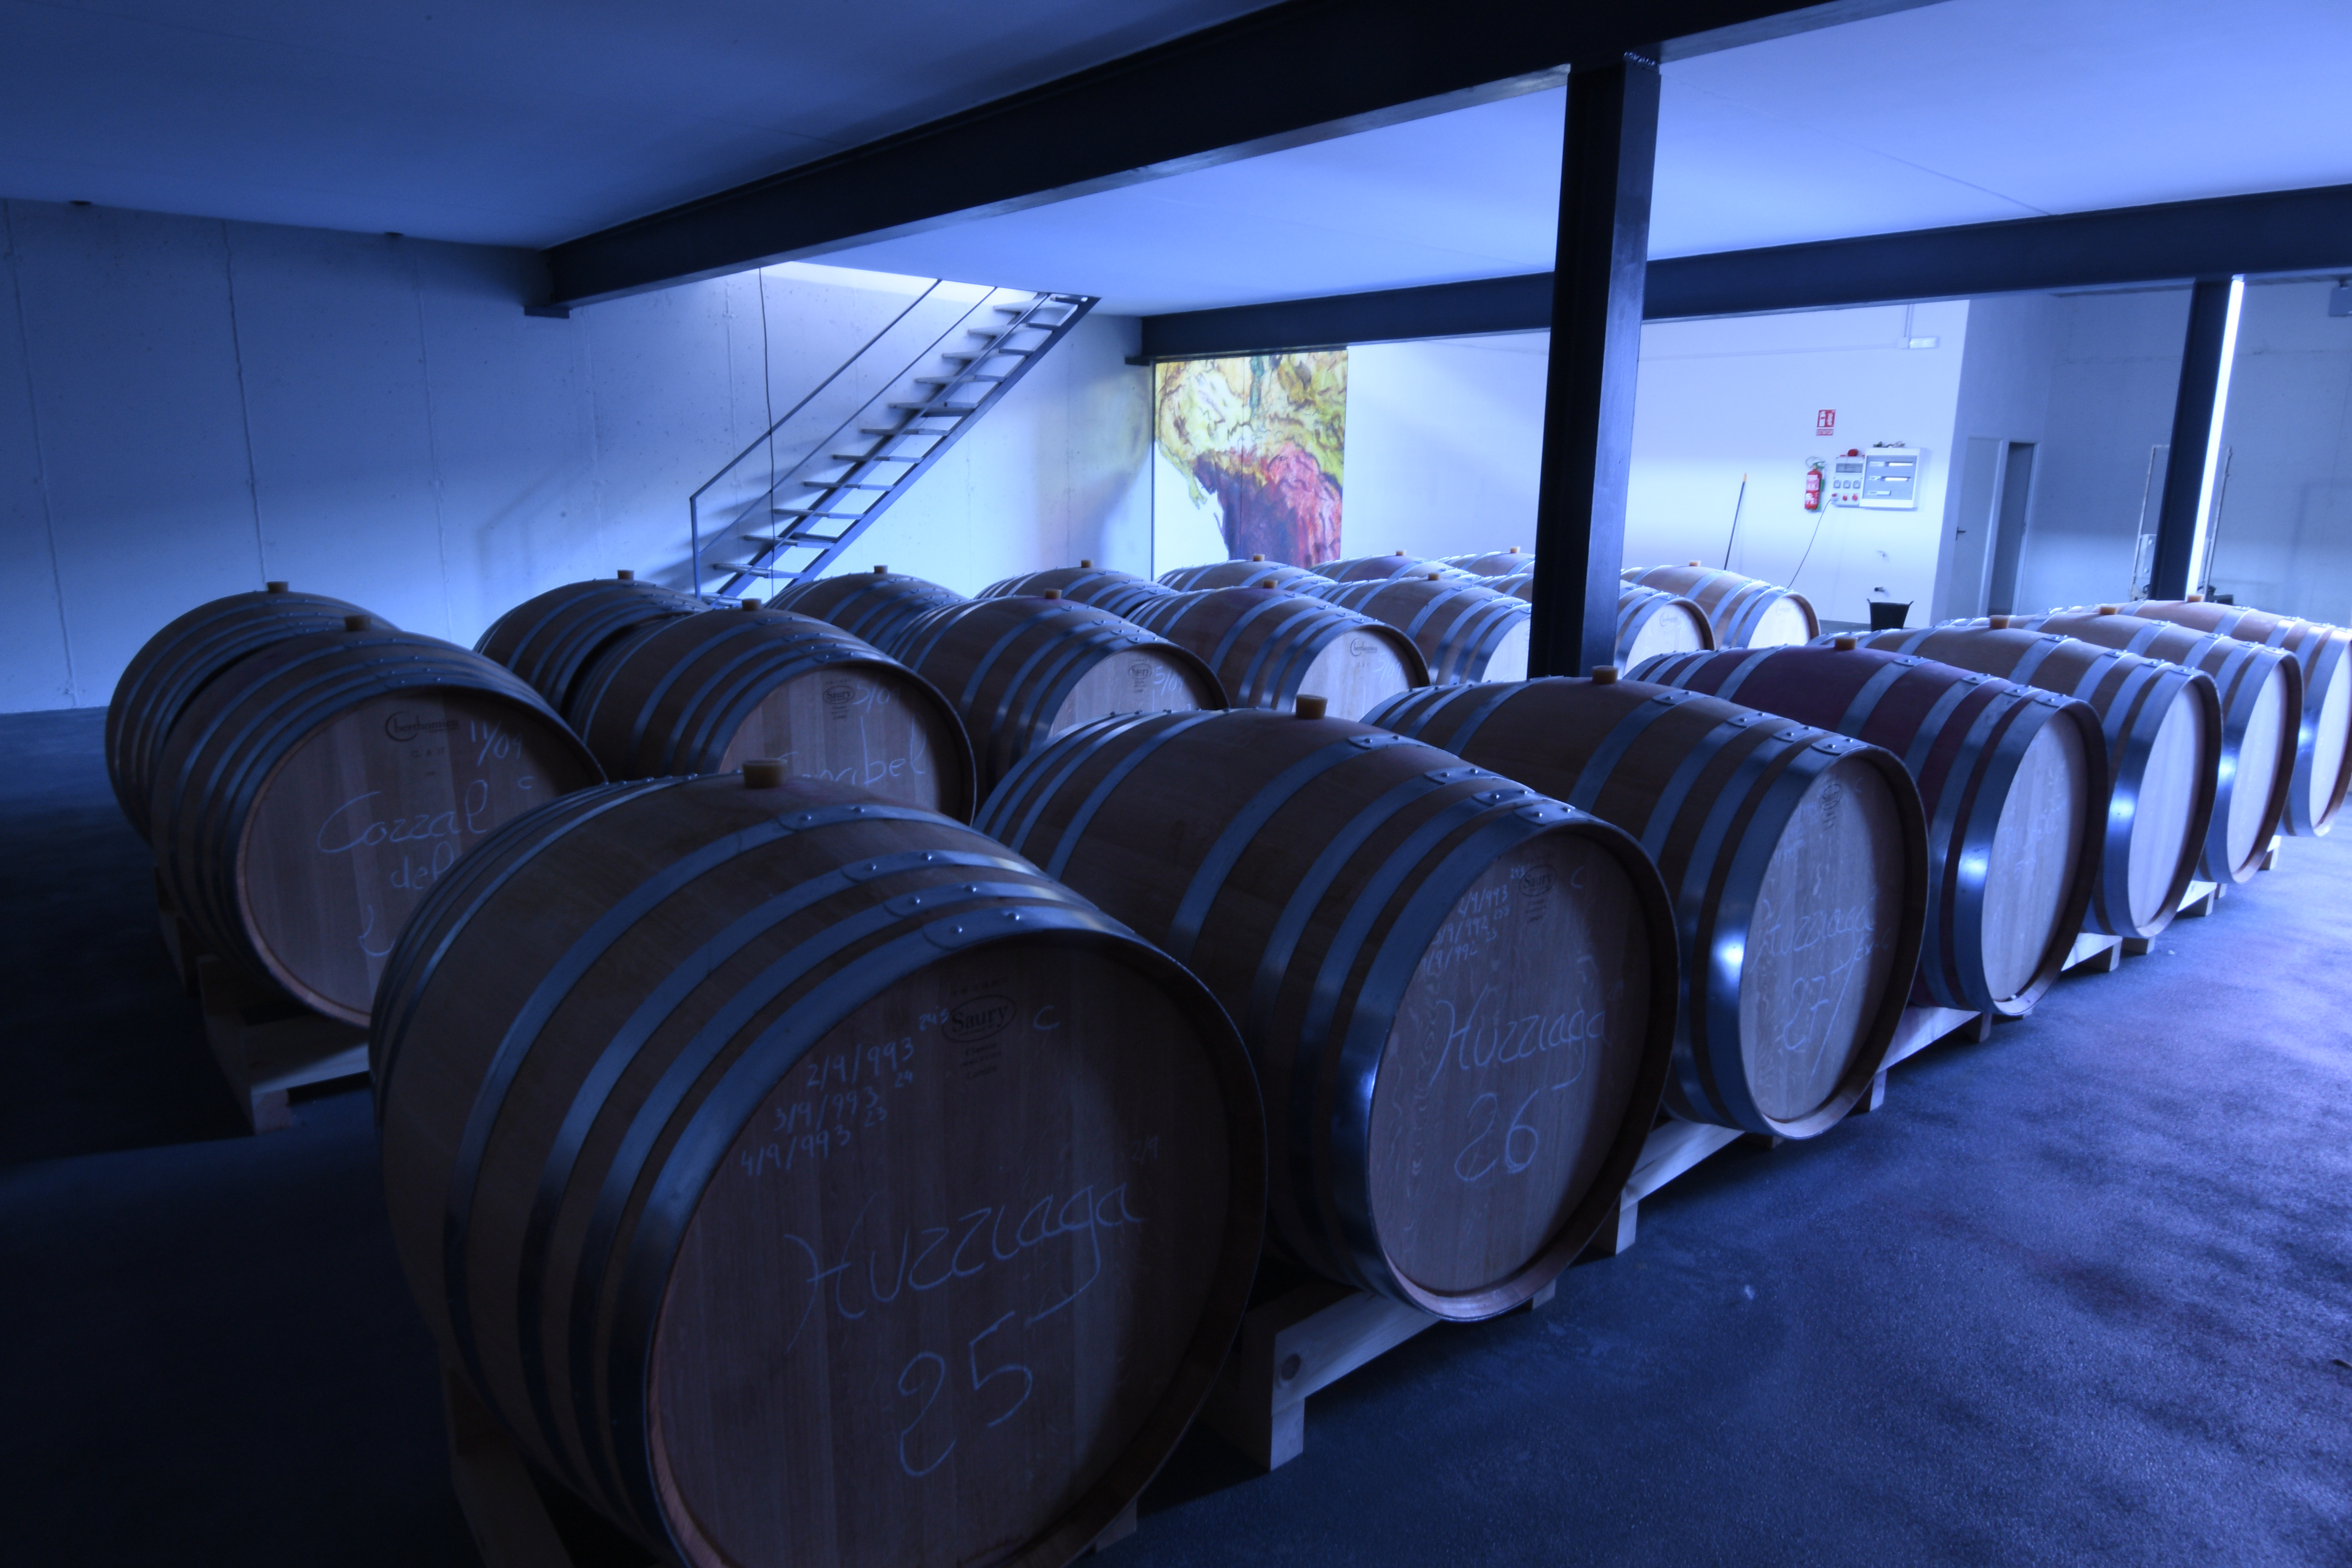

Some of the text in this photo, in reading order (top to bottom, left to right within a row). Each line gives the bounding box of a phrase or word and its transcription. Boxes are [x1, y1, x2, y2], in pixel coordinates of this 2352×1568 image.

[1524, 874, 1552, 889] Saury
[951, 1004, 1009, 1033] Saury
[806, 1037, 914, 1090] 2/9/993
[740, 1124, 852, 1177] 4/9/993
[1453, 1089, 1541, 1184] 26
[898, 1310, 1033, 1478] 25
